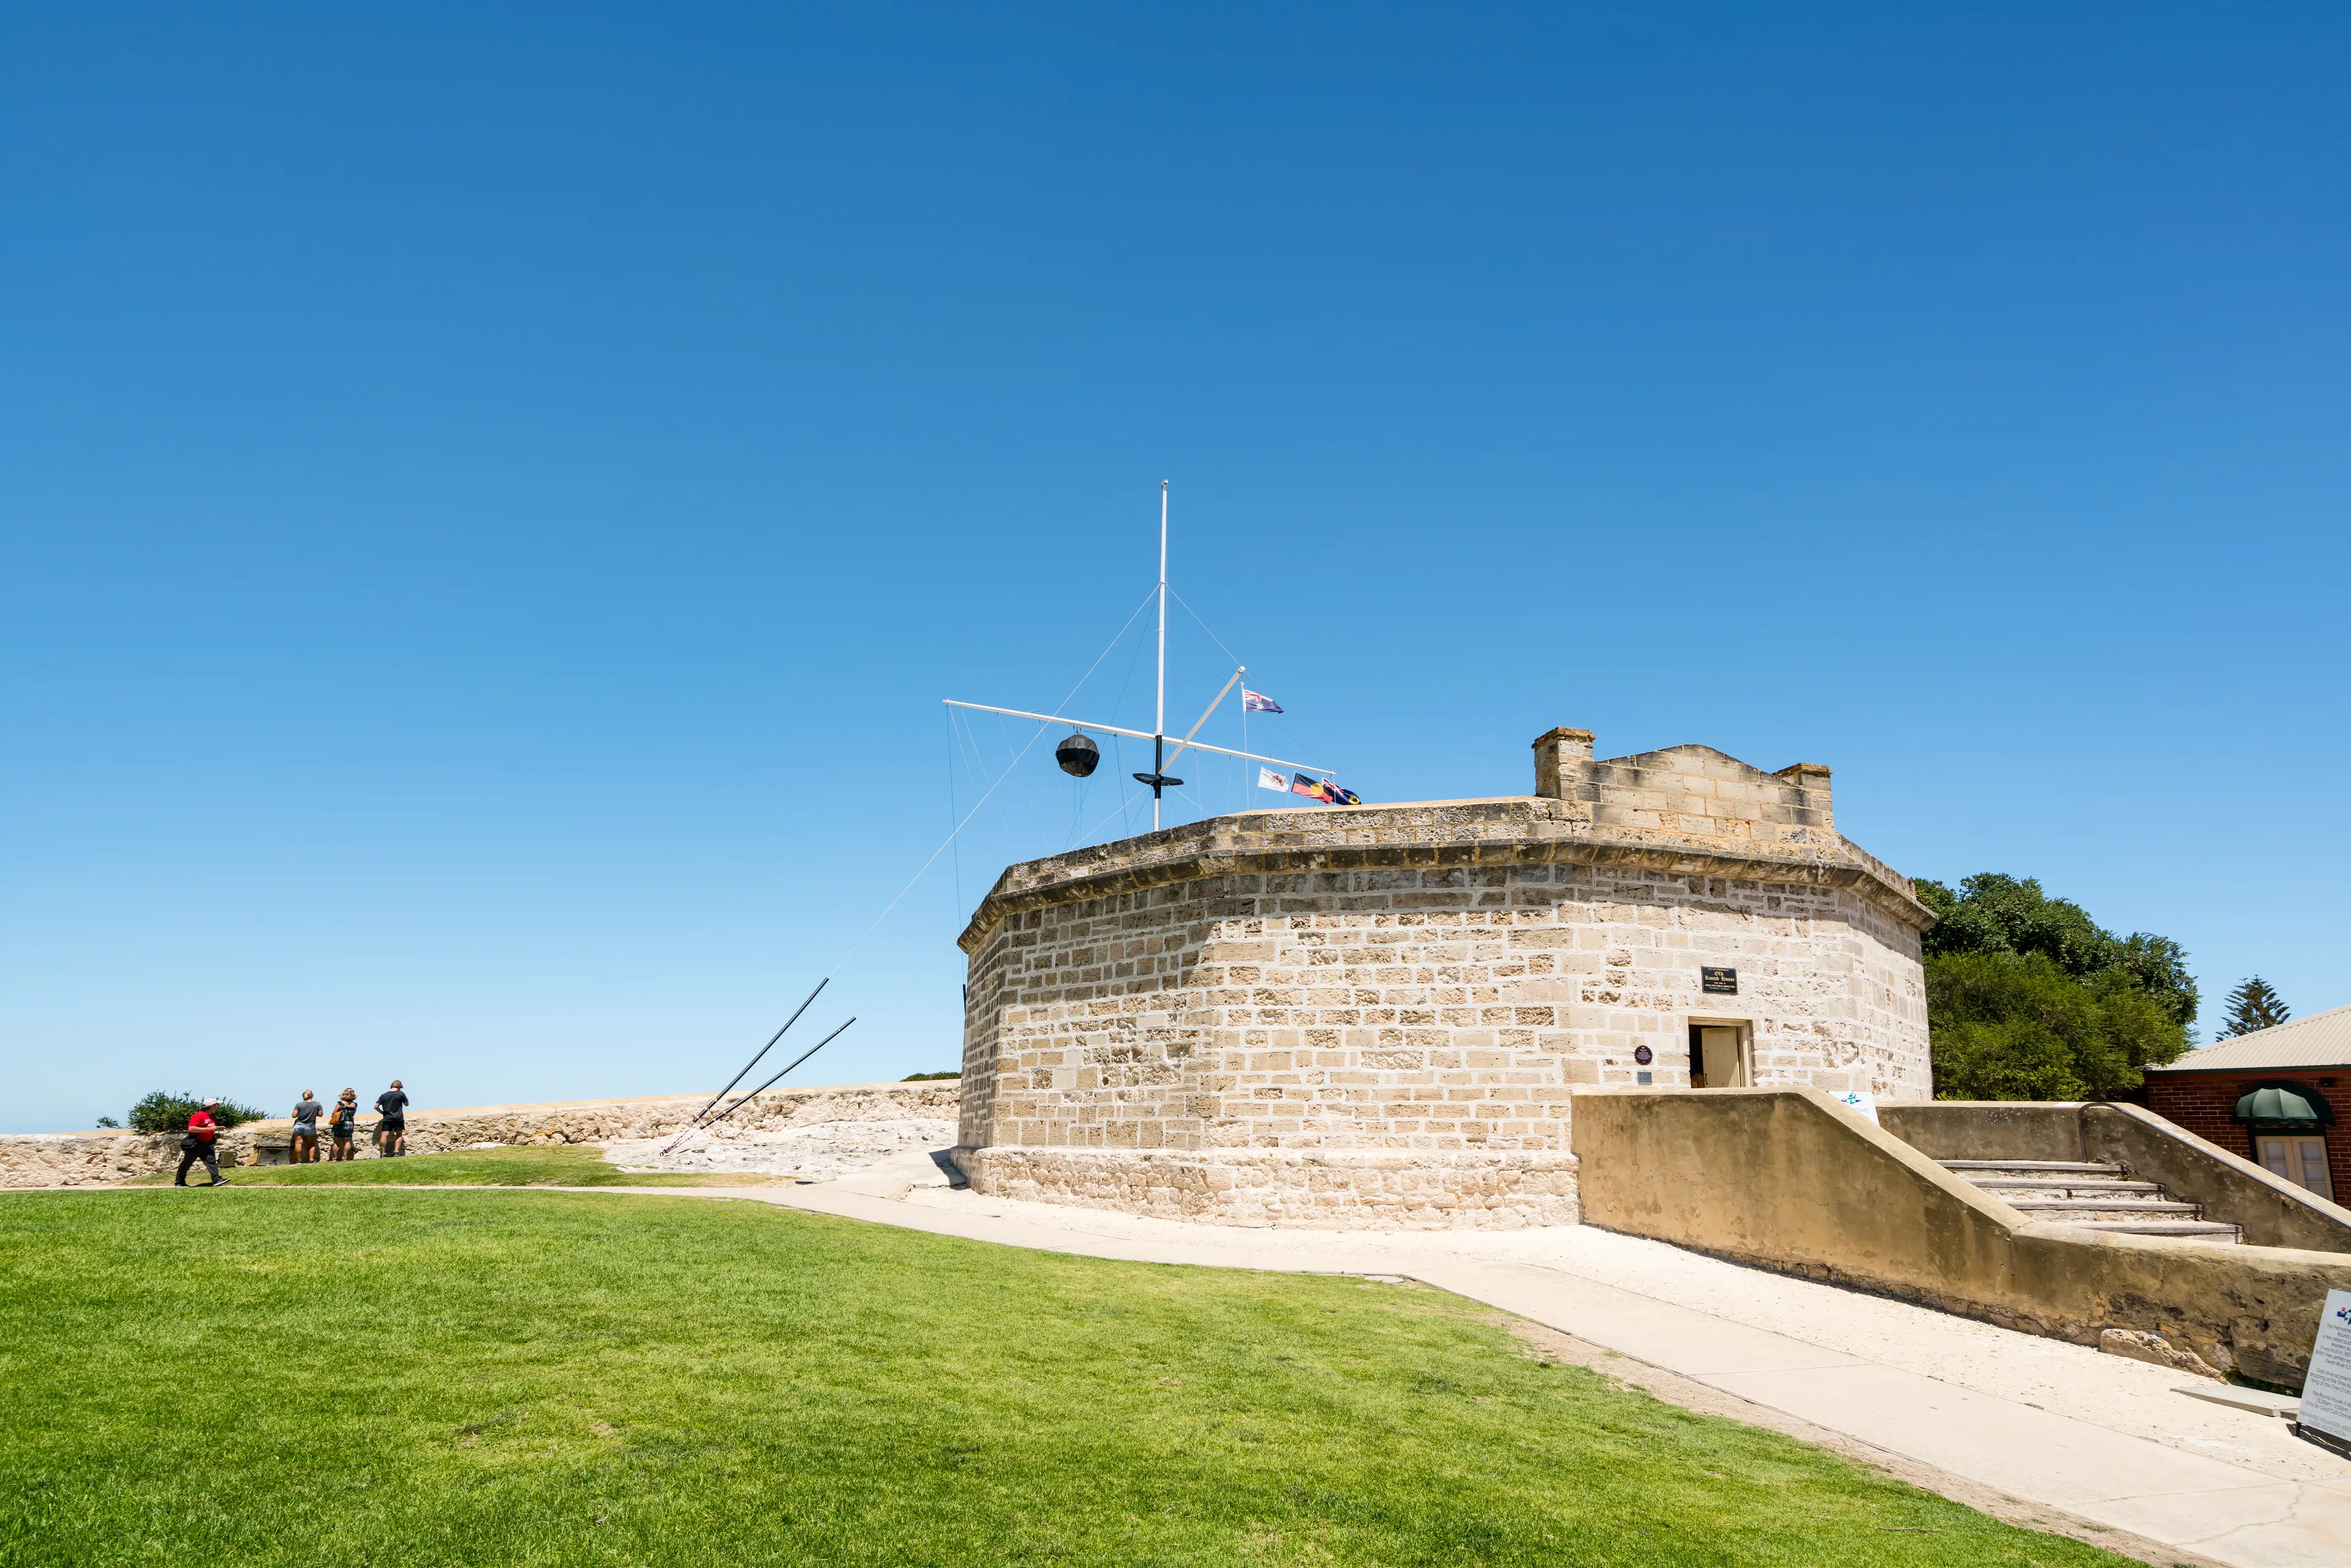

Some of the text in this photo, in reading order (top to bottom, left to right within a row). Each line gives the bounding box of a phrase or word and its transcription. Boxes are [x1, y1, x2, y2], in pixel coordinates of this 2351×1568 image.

[2309, 1372, 2325, 1381] dropping
[2300, 1410, 2319, 1420] FREMANTLE
[2319, 1417, 2340, 1428] VOLUNTEER
[2308, 1419, 2346, 1436] GUIDES ASSOCIATION
